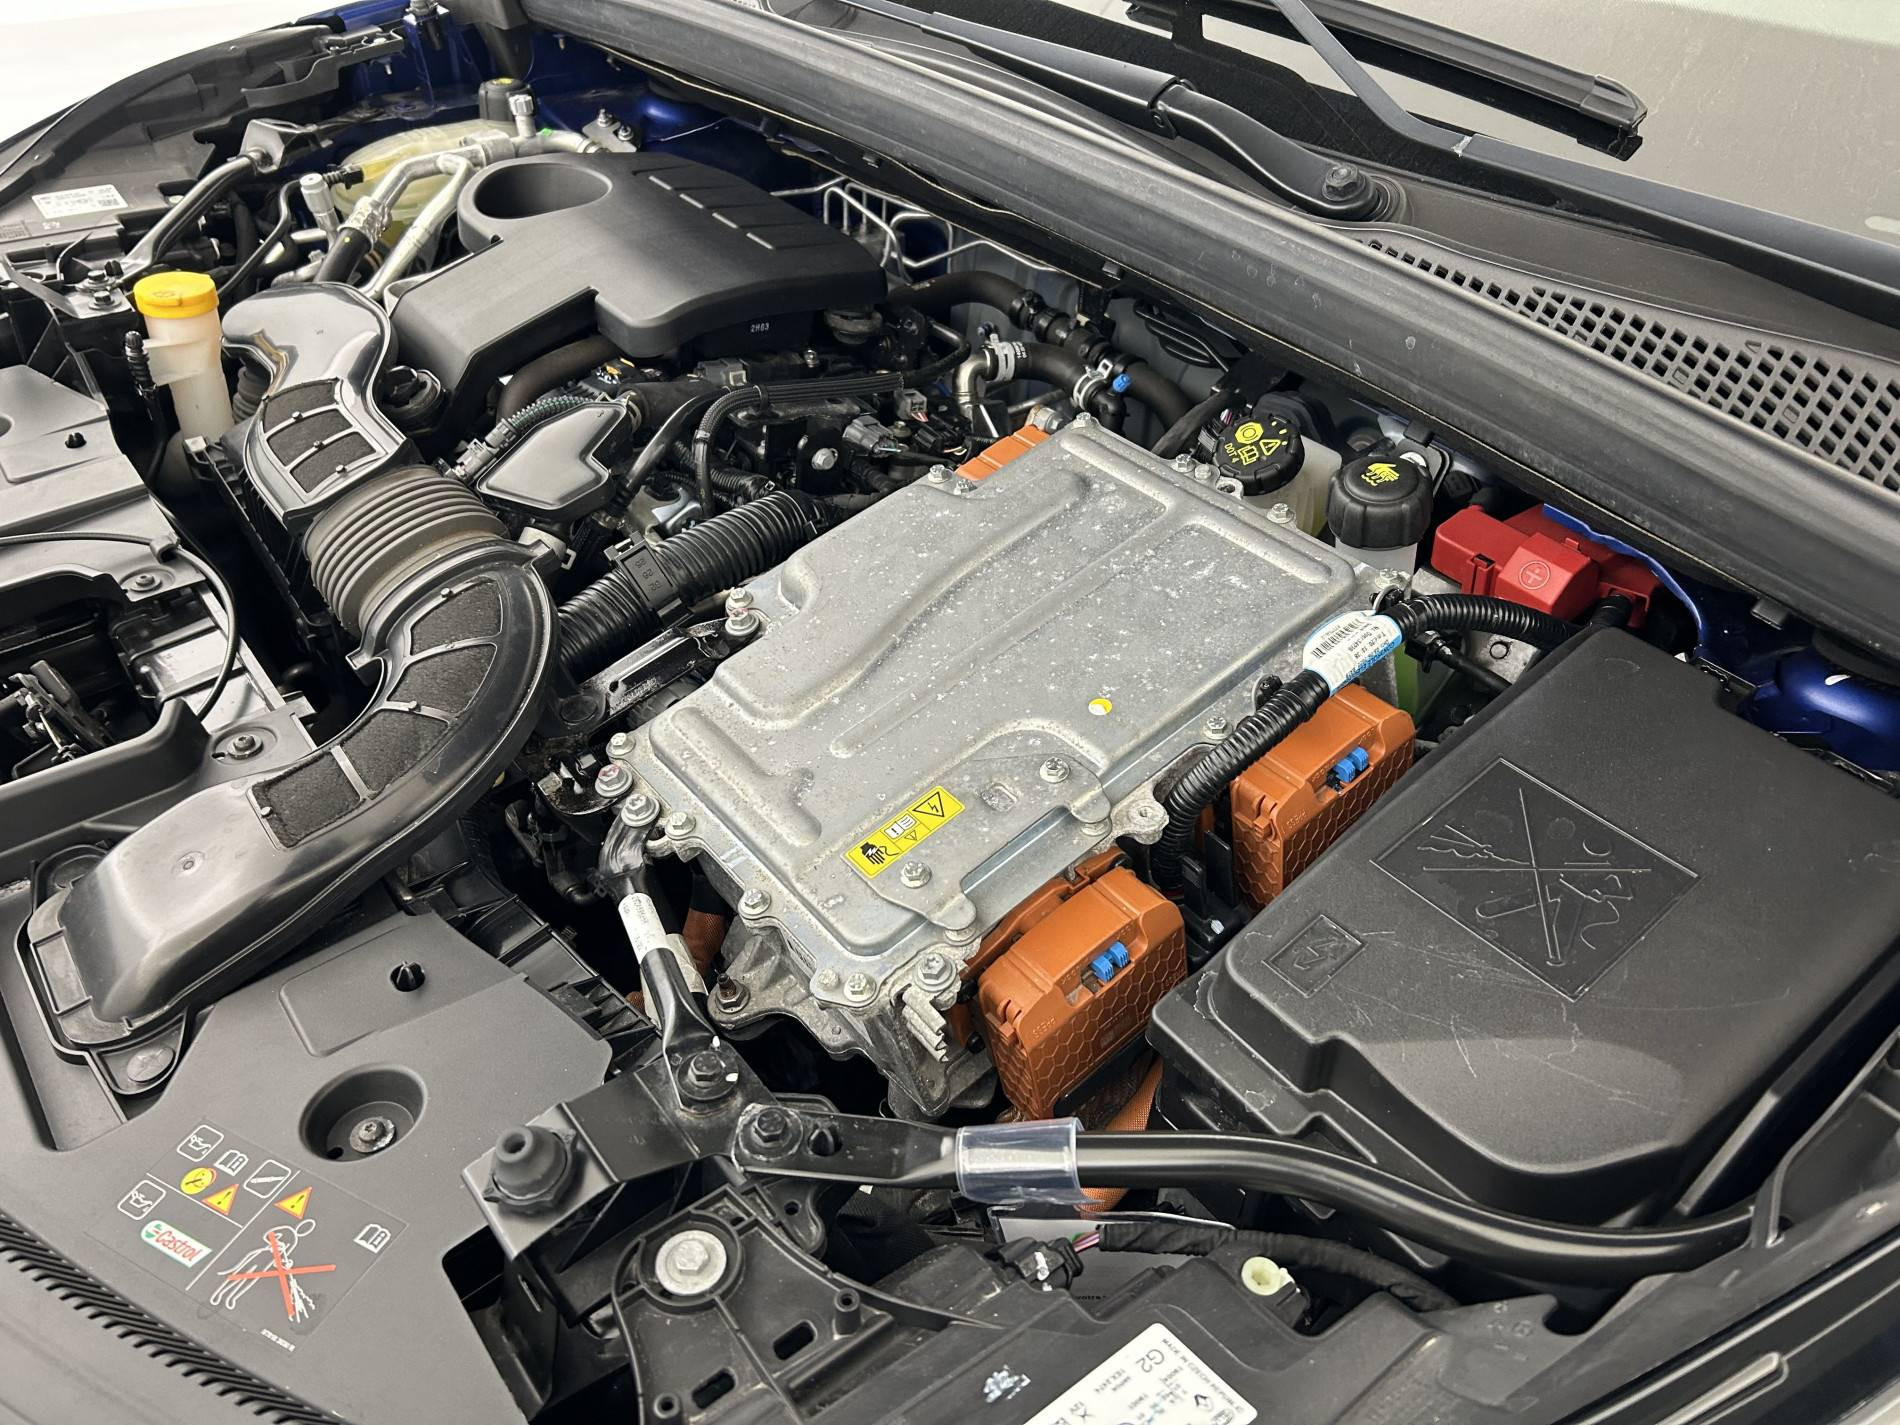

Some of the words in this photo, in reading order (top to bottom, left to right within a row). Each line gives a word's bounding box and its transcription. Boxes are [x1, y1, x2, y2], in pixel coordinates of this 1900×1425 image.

[1224, 442, 1237, 457] DOT
[155, 1230, 203, 1262] Castrol
[1135, 1348, 1165, 1373] G2
